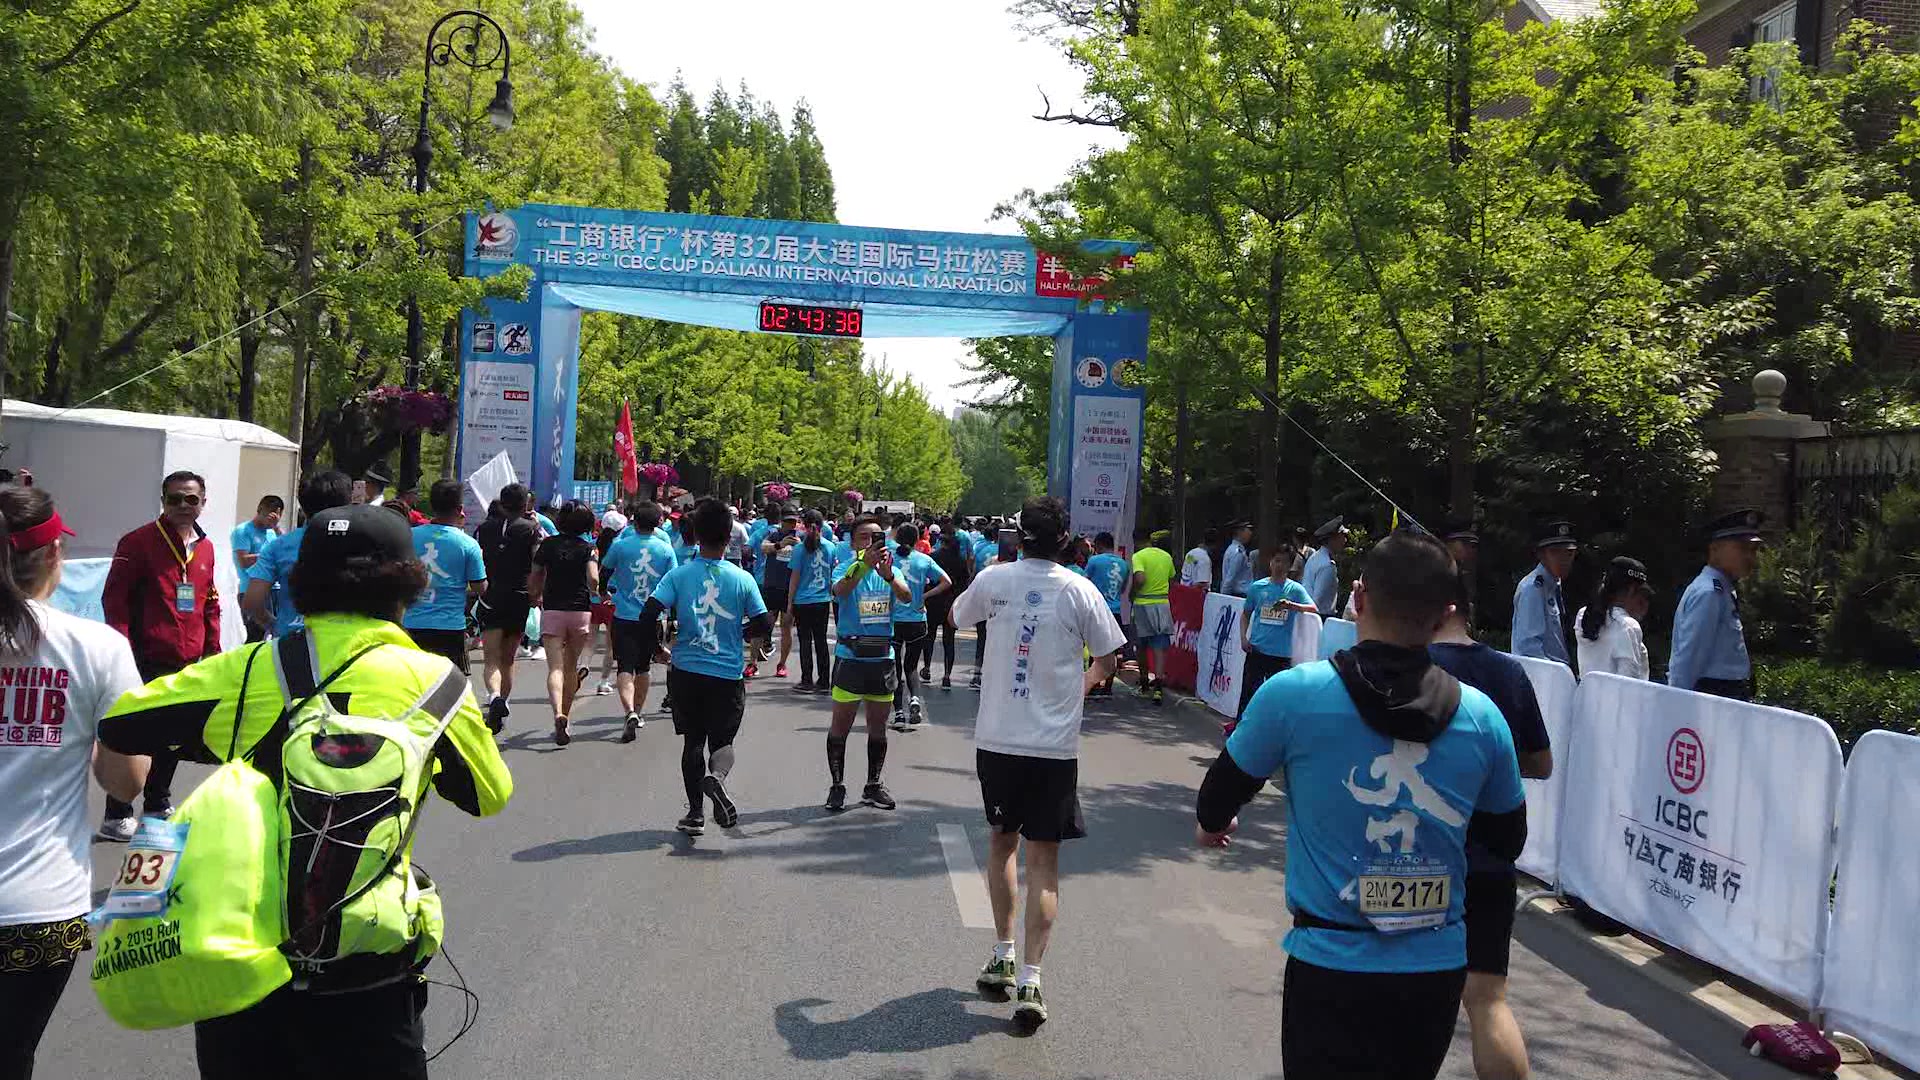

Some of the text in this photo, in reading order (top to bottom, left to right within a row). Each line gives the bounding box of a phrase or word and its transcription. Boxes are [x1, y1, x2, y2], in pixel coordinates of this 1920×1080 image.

[532, 248, 570, 265] THE
[614, 254, 656, 271] ICBC
[659, 257, 698, 273] CUP
[702, 260, 770, 278] DALIAN
[774, 264, 919, 288] INTERNATIONAL
[923, 274, 1027, 295] MARATHON
[1040, 281, 1061, 290] HALF
[762, 306, 860, 334] 02:43:38
[1655, 795, 1708, 840] ICBC
[1366, 880, 1443, 908] 2M 2171
[127, 919, 180, 947] 2019 RUN
[111, 936, 181, 975] MARATHON
